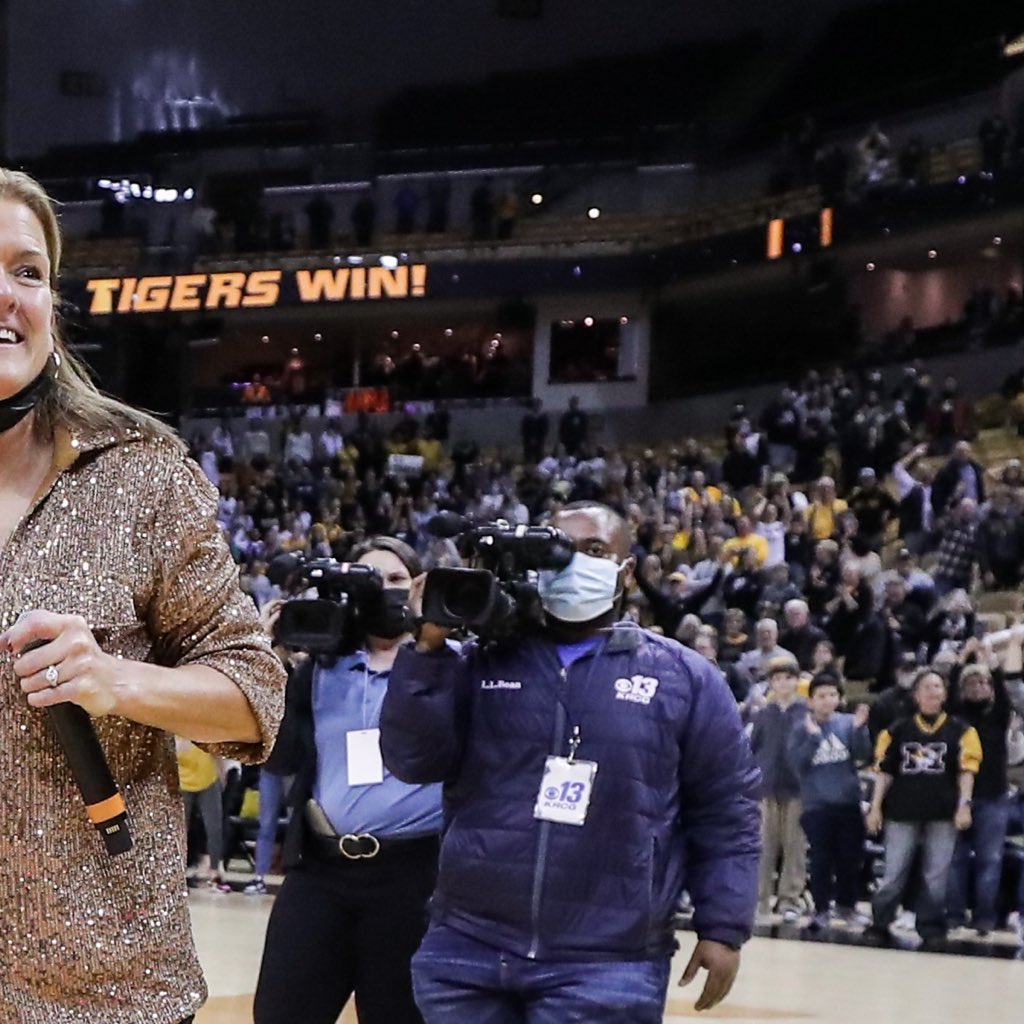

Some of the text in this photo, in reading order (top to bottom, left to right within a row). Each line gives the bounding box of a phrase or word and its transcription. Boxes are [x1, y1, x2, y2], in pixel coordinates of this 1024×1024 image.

[86, 264, 426, 315] TIGERS WIN!
[631, 674, 659, 698] 13
[559, 781, 586, 803] 13
